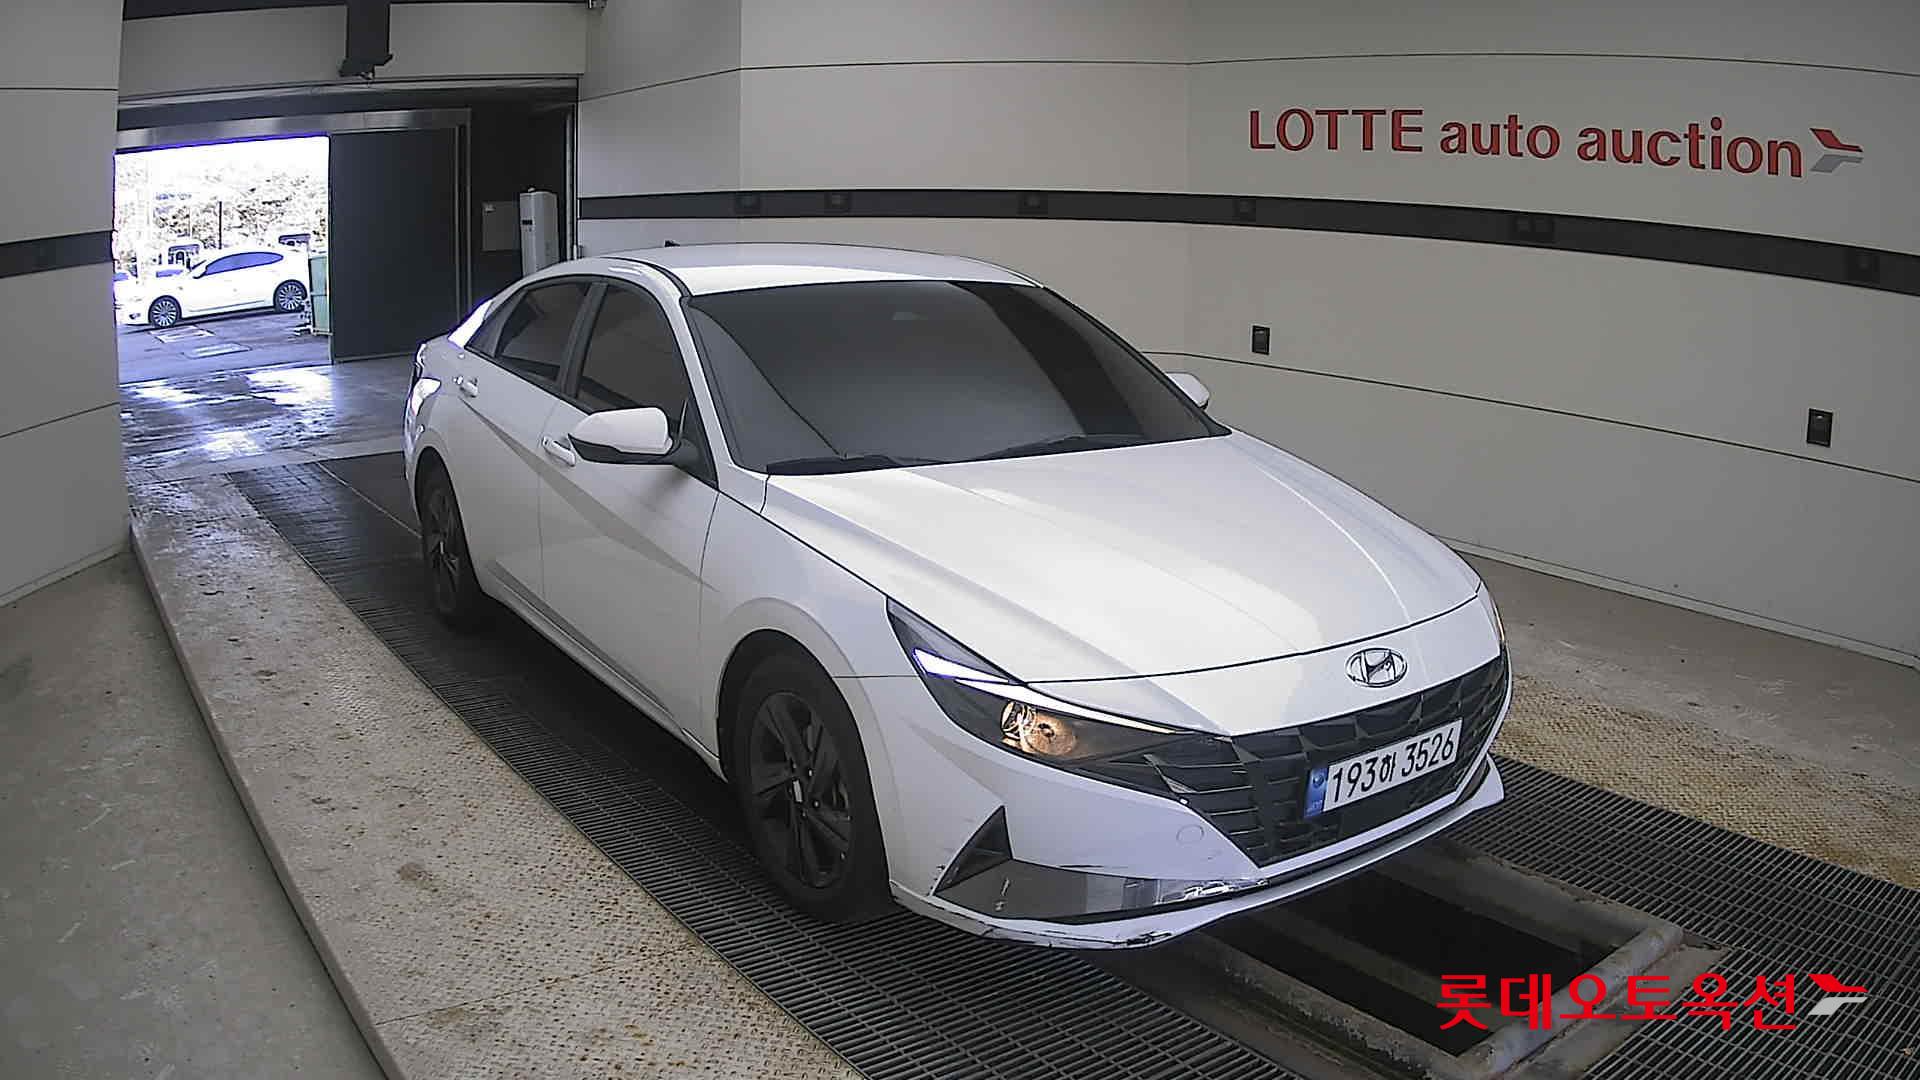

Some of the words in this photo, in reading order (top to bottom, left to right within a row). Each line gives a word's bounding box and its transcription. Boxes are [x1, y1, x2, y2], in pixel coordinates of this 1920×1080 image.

[1249, 109, 1424, 153] LOTTE
[1440, 114, 1561, 160] auto
[1576, 117, 1803, 178] auction
[1332, 751, 1397, 803] 193하
[1401, 727, 1454, 778] 3526
